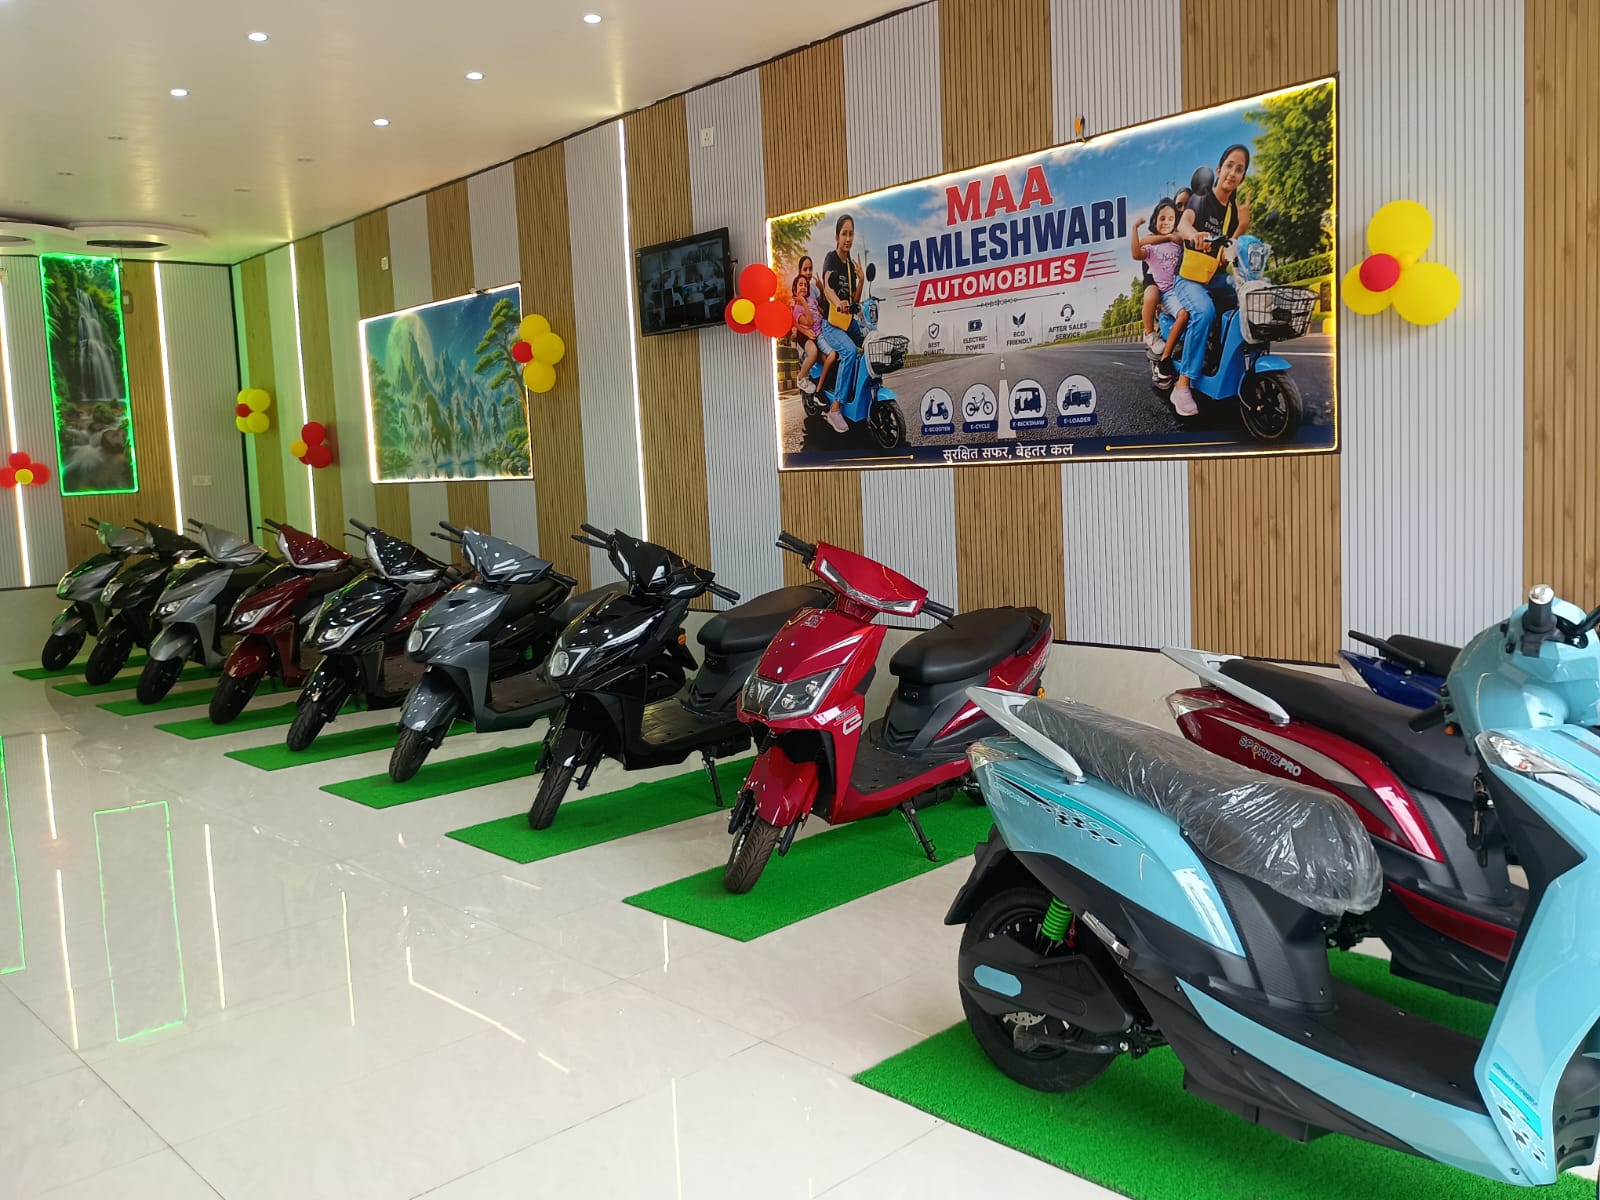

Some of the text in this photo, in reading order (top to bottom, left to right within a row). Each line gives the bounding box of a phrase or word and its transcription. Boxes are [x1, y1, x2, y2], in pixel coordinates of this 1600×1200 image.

[945, 164, 1054, 227] MAA
[887, 196, 1127, 280] BAMLESHWARI
[922, 258, 1077, 302] AUTOMOBILES
[1048, 322, 1088, 333] AFTER SALES
[1013, 330, 1026, 338] ECO
[1055, 331, 1081, 340] SERVICE
[962, 335, 988, 344] ELECTRIC
[1006, 337, 1033, 347] FRIENDLY
[927, 341, 941, 349] BEST
[965, 343, 986, 352] POWER
[923, 348, 945, 357] QUALITY
[1063, 416, 1092, 425] E-LOADER
[942, 442, 1074, 465] सुरक्षित सफर, बेहतर कल
